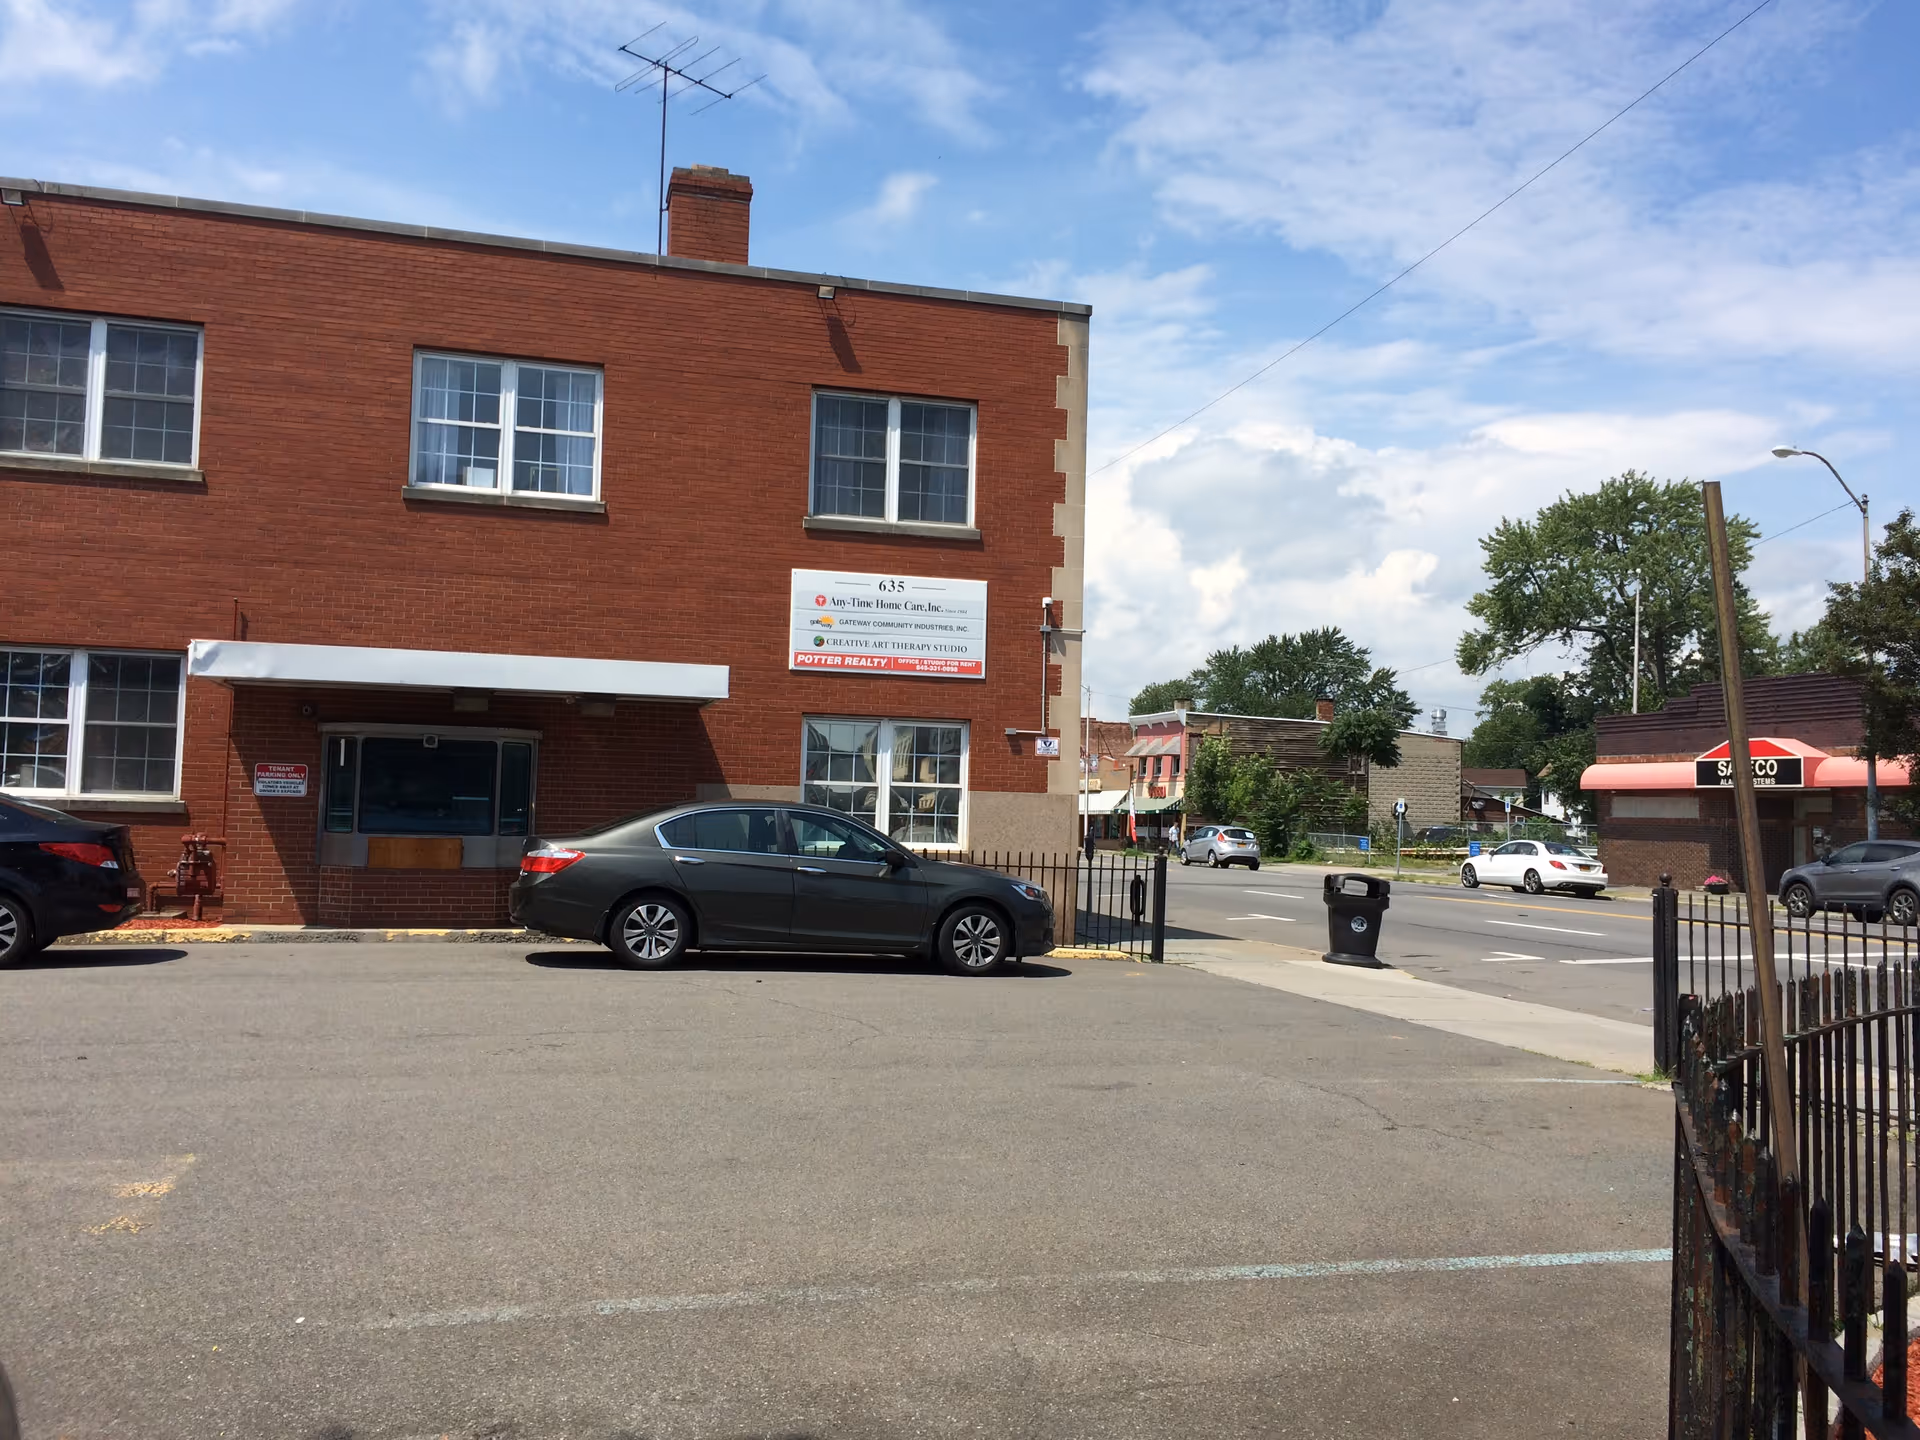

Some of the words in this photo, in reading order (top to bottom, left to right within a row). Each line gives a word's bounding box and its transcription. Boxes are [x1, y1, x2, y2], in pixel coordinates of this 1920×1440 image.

[879, 579, 905, 593] 635
[829, 597, 873, 609] Any-Time
[876, 599, 902, 610] Home
[839, 618, 872, 627] GATEWAY
[872, 620, 914, 630] COMMUNITY
[914, 623, 956, 633] INDUSTRIES,
[956, 625, 970, 633] INC.
[826, 638, 871, 648] CREATIVE
[871, 641, 890, 649] ART
[891, 642, 932, 652] THERAPY
[933, 644, 968, 653] STUDIO
[797, 654, 842, 665] POTTER
[844, 656, 888, 668] REALTY
